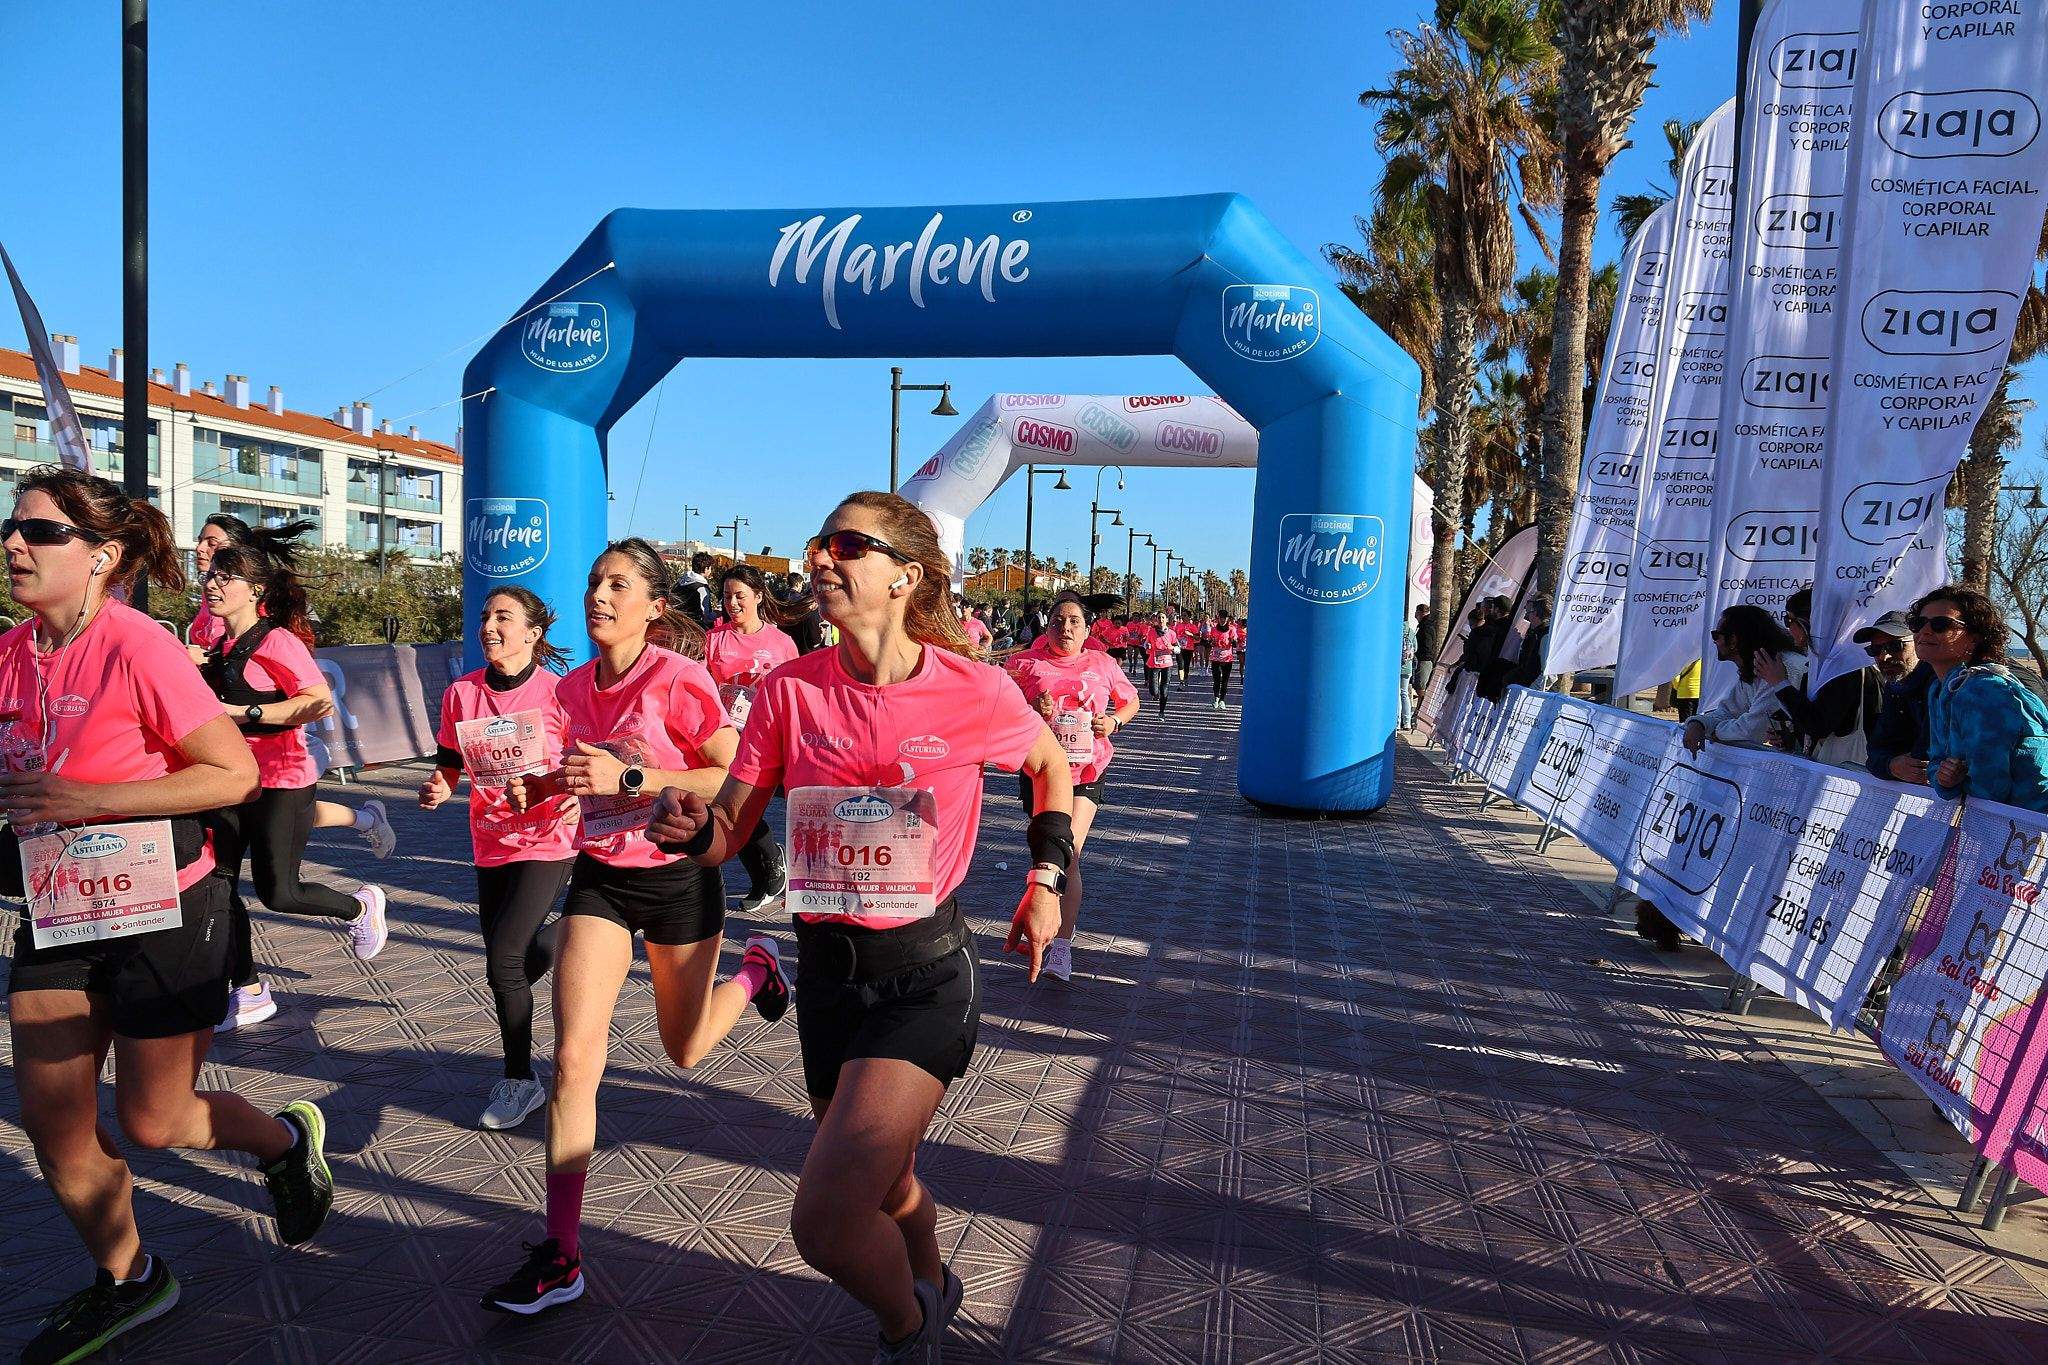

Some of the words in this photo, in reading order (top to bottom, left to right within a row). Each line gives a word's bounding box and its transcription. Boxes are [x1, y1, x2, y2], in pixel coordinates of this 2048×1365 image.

[1922, 0, 2021, 20] CORPORAL
[1923, 26, 1933, 40] Y
[1936, 22, 2015, 40] CAPILAR
[1900, 109, 2016, 147] ziaja
[1790, 139, 1800, 150] Y
[1871, 178, 1968, 196] COSMÉTICA
[1973, 180, 2039, 195] FACIAL,
[1903, 201, 1996, 216] CORPORAL
[1903, 222, 1912, 236] Y
[1914, 222, 1990, 237] CAPILAR
[769, 212, 1029, 330] Marlene
[1826, 267, 1837, 279] F
[1774, 300, 1783, 311] Y
[1229, 301, 1313, 342] Marlene
[1881, 307, 1997, 347] ziaja
[528, 317, 602, 353] Marlene
[1234, 340, 1250, 354] HIJA
[1252, 349, 1263, 357] DE
[1264, 350, 1280, 358] LOS
[1282, 339, 1307, 355] ALPES
[530, 349, 544, 363] HIJA
[546, 359, 556, 367] DE
[558, 360, 573, 368] LOS
[575, 353, 597, 367] ALPES
[1683, 374, 1690, 385] Y
[1854, 373, 1948, 391] COSMÉTICA
[1880, 392, 1978, 411] CORPORAL
[1735, 422, 1808, 438] COSMÉTICA
[1883, 416, 1894, 430] Y
[1898, 411, 1972, 431] CAPILAR
[1018, 420, 1073, 453] COSMO
[1162, 424, 1219, 455] COSMO
[1761, 457, 1769, 469] Y
[1770, 458, 1822, 470] CAPILA
[1666, 498, 1674, 507] Y
[469, 515, 542, 555] Marlene
[493, 565, 508, 573] LOS
[510, 556, 535, 572] ALPES
[1285, 533, 1376, 578] Marlene
[1288, 575, 1305, 592] HIJA
[1307, 587, 1319, 597] DE
[1342, 581, 1368, 597] ALPES
[1720, 576, 1799, 590] COSMÉTICA
[801, 732, 853, 750] OYSHO
[904, 743, 945, 754] ASTURIANA
[491, 745, 523, 761] 016
[838, 804, 890, 817] ASTURIANA
[1651, 793, 1726, 872] ziaja
[1750, 802, 1807, 837] COSMÉTICA
[1807, 822, 1850, 856] FACIAL,
[72, 841, 124, 855] ASTURIANA
[837, 845, 892, 866] 016
[851, 871, 870, 881] 192
[1786, 850, 1796, 871] Y
[1797, 856, 1846, 891] CAPILAR
[78, 873, 132, 897] 016
[804, 881, 835, 890] CARRERA
[857, 884, 880, 892] MUJER
[92, 899, 116, 909] 5974
[802, 894, 847, 907] OYSHO
[875, 900, 918, 909] Santander
[52, 914, 82, 925] CARRERA
[101, 908, 124, 919] MUJER
[129, 902, 162, 913] VALENCIA
[1765, 890, 1833, 945] ziaja.es
[52, 925, 96, 940] OYSHO
[122, 916, 166, 931] Santander
